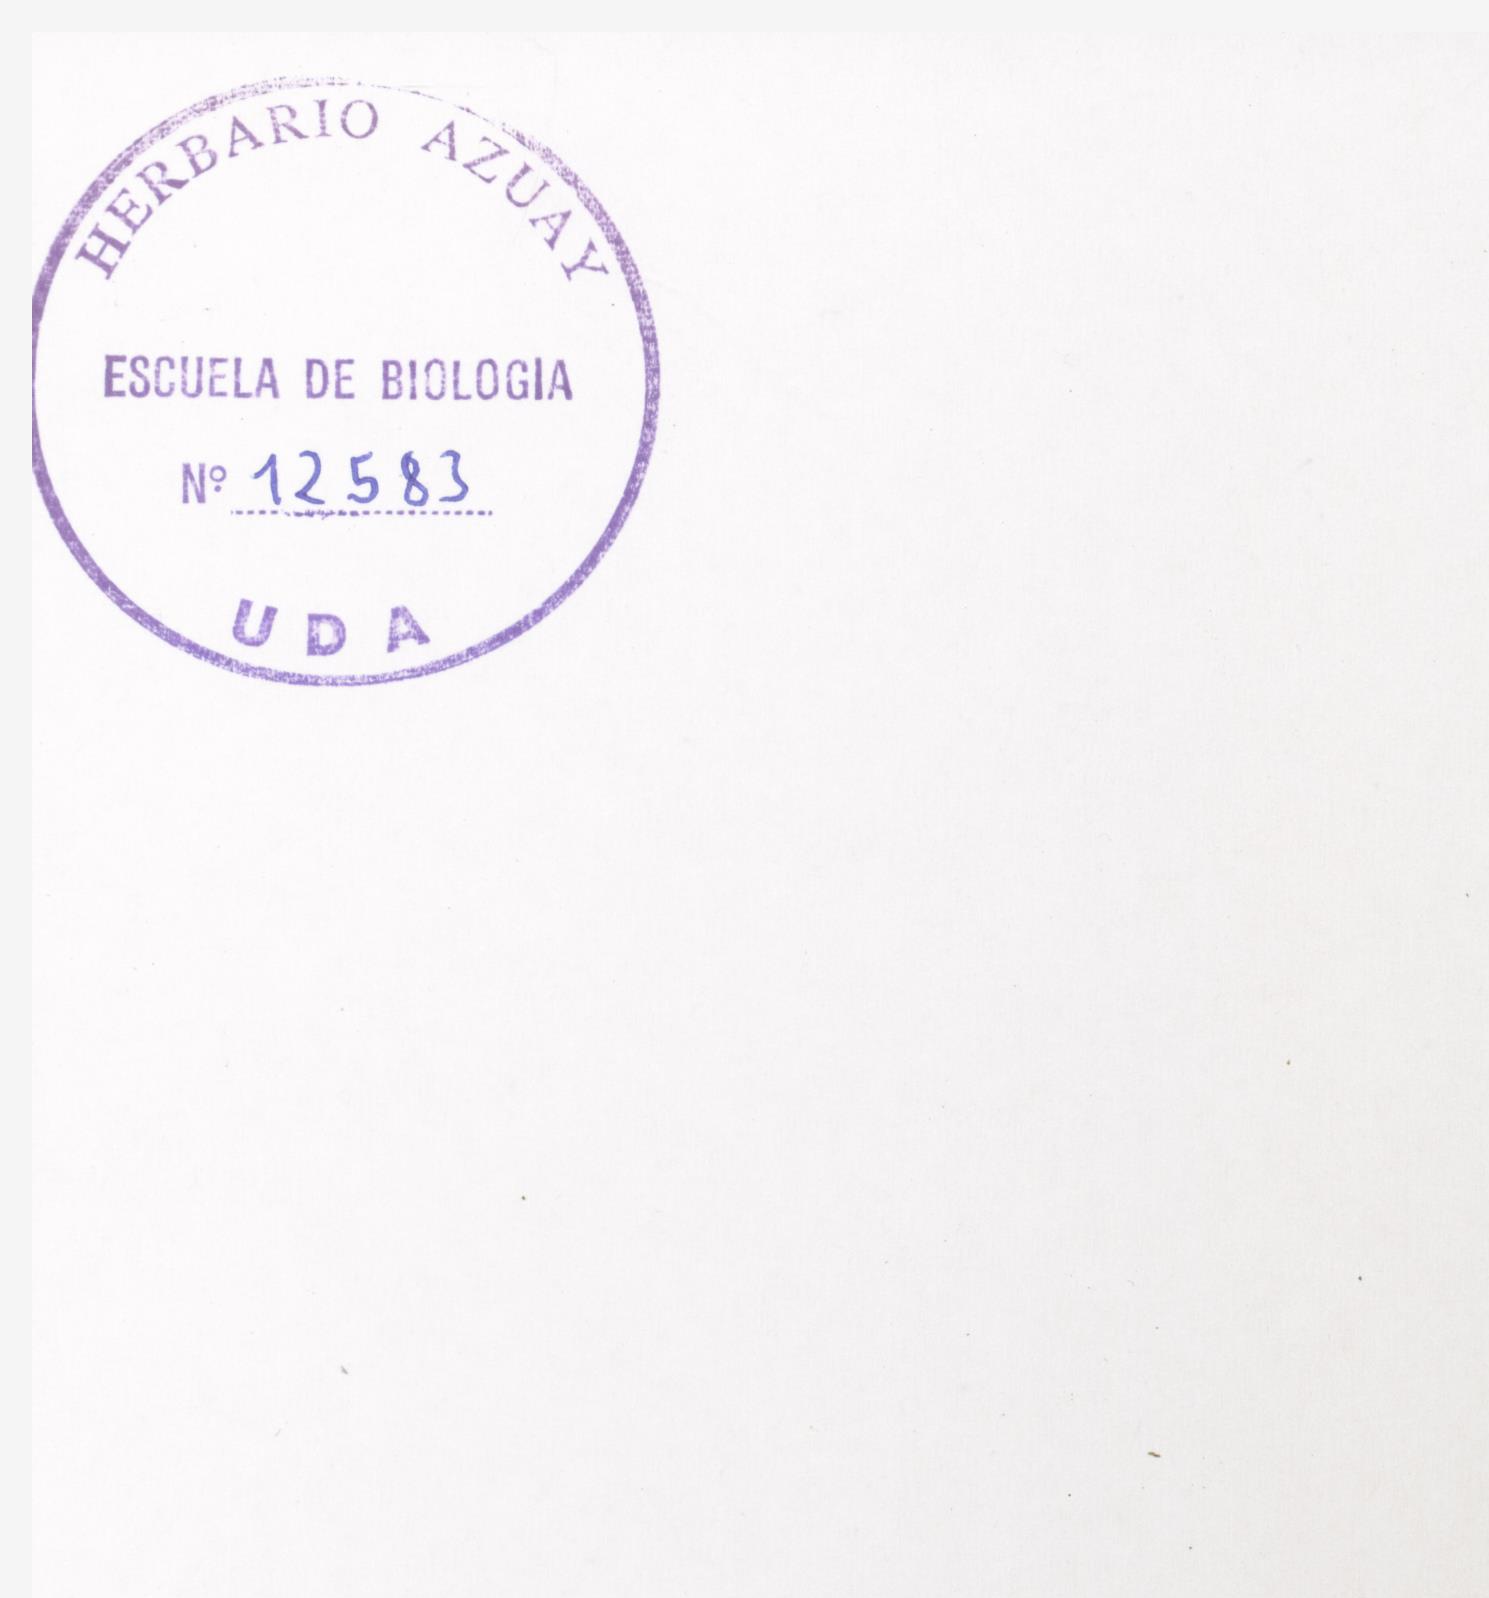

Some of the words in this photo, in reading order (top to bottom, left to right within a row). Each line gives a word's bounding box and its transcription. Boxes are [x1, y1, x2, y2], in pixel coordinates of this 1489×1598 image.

[74, 99, 379, 280] HERBARIO
[421, 119, 609, 282] AZUAY
[103, 354, 281, 400] ESCUELA
[304, 357, 356, 400] DE
[381, 355, 574, 401] BIOLOGIA
[249, 449, 471, 507] 12583
